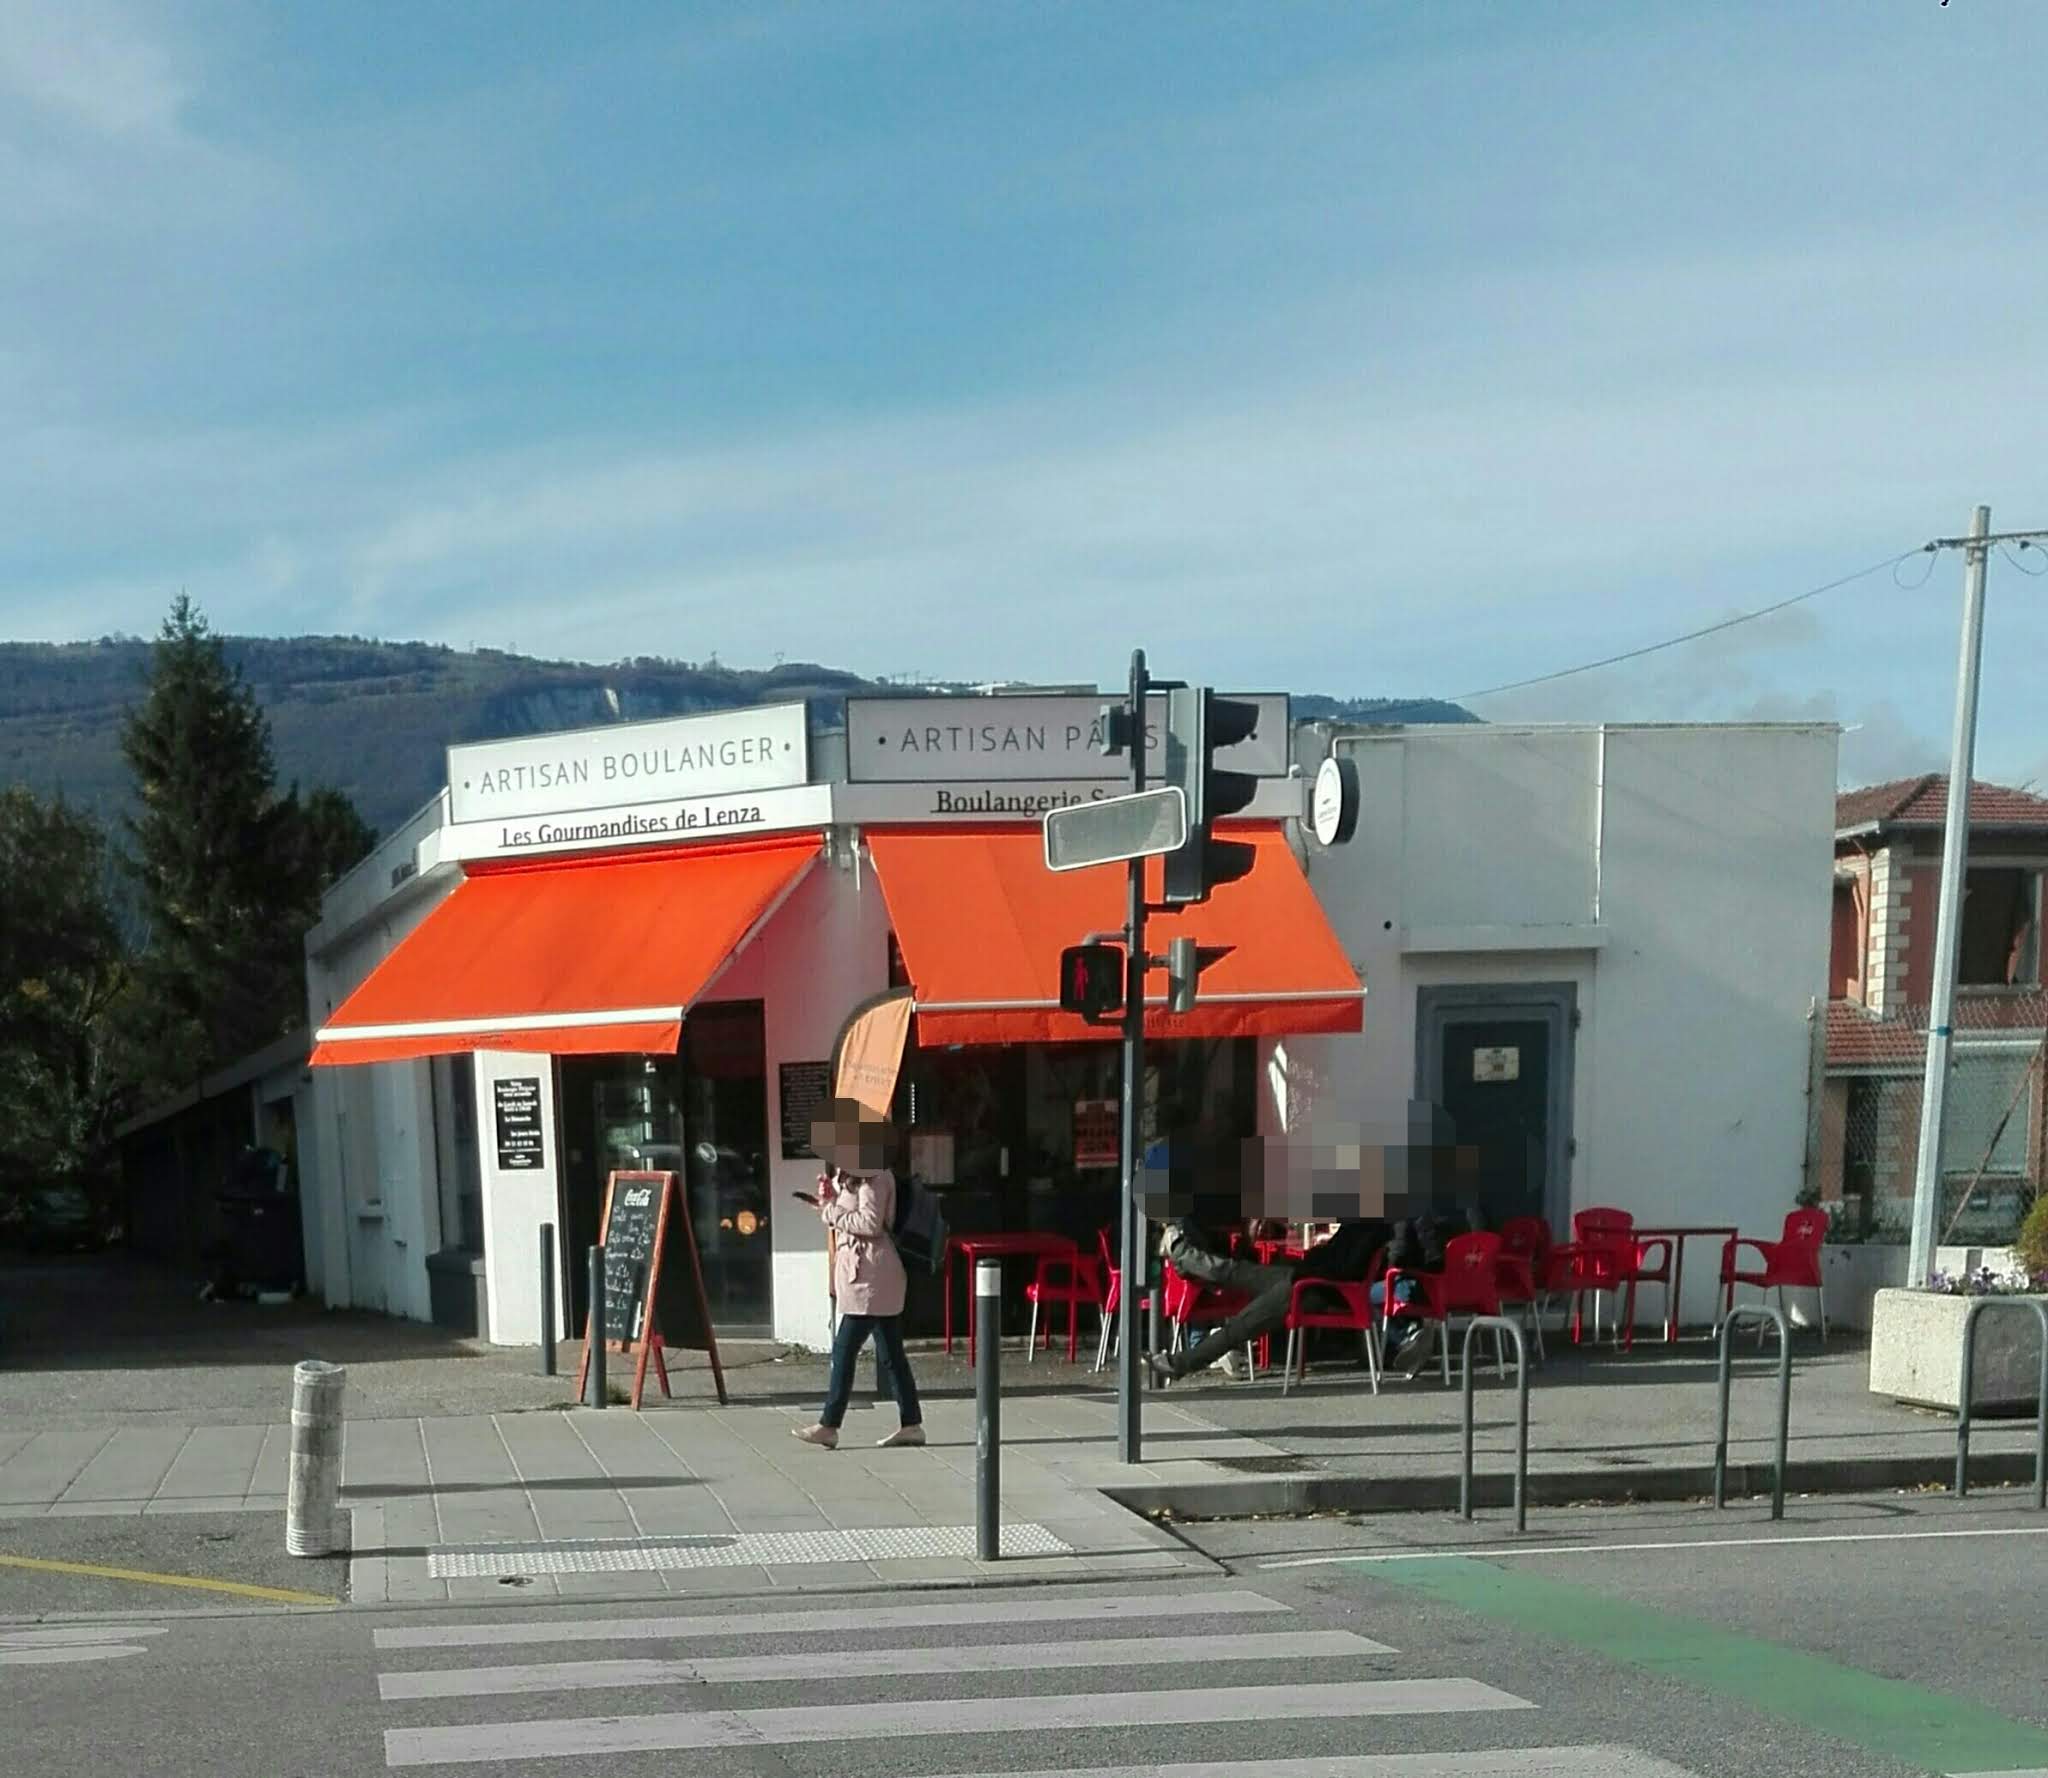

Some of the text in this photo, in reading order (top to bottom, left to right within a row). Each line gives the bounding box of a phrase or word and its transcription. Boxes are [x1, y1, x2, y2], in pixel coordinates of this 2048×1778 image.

[901, 725, 1045, 752] ARTISAN
[480, 737, 774, 794] ARTISAN BOULANGER
[936, 789, 1082, 817] Boulangerie
[501, 804, 762, 848] Les Gourmandises de Lenza
